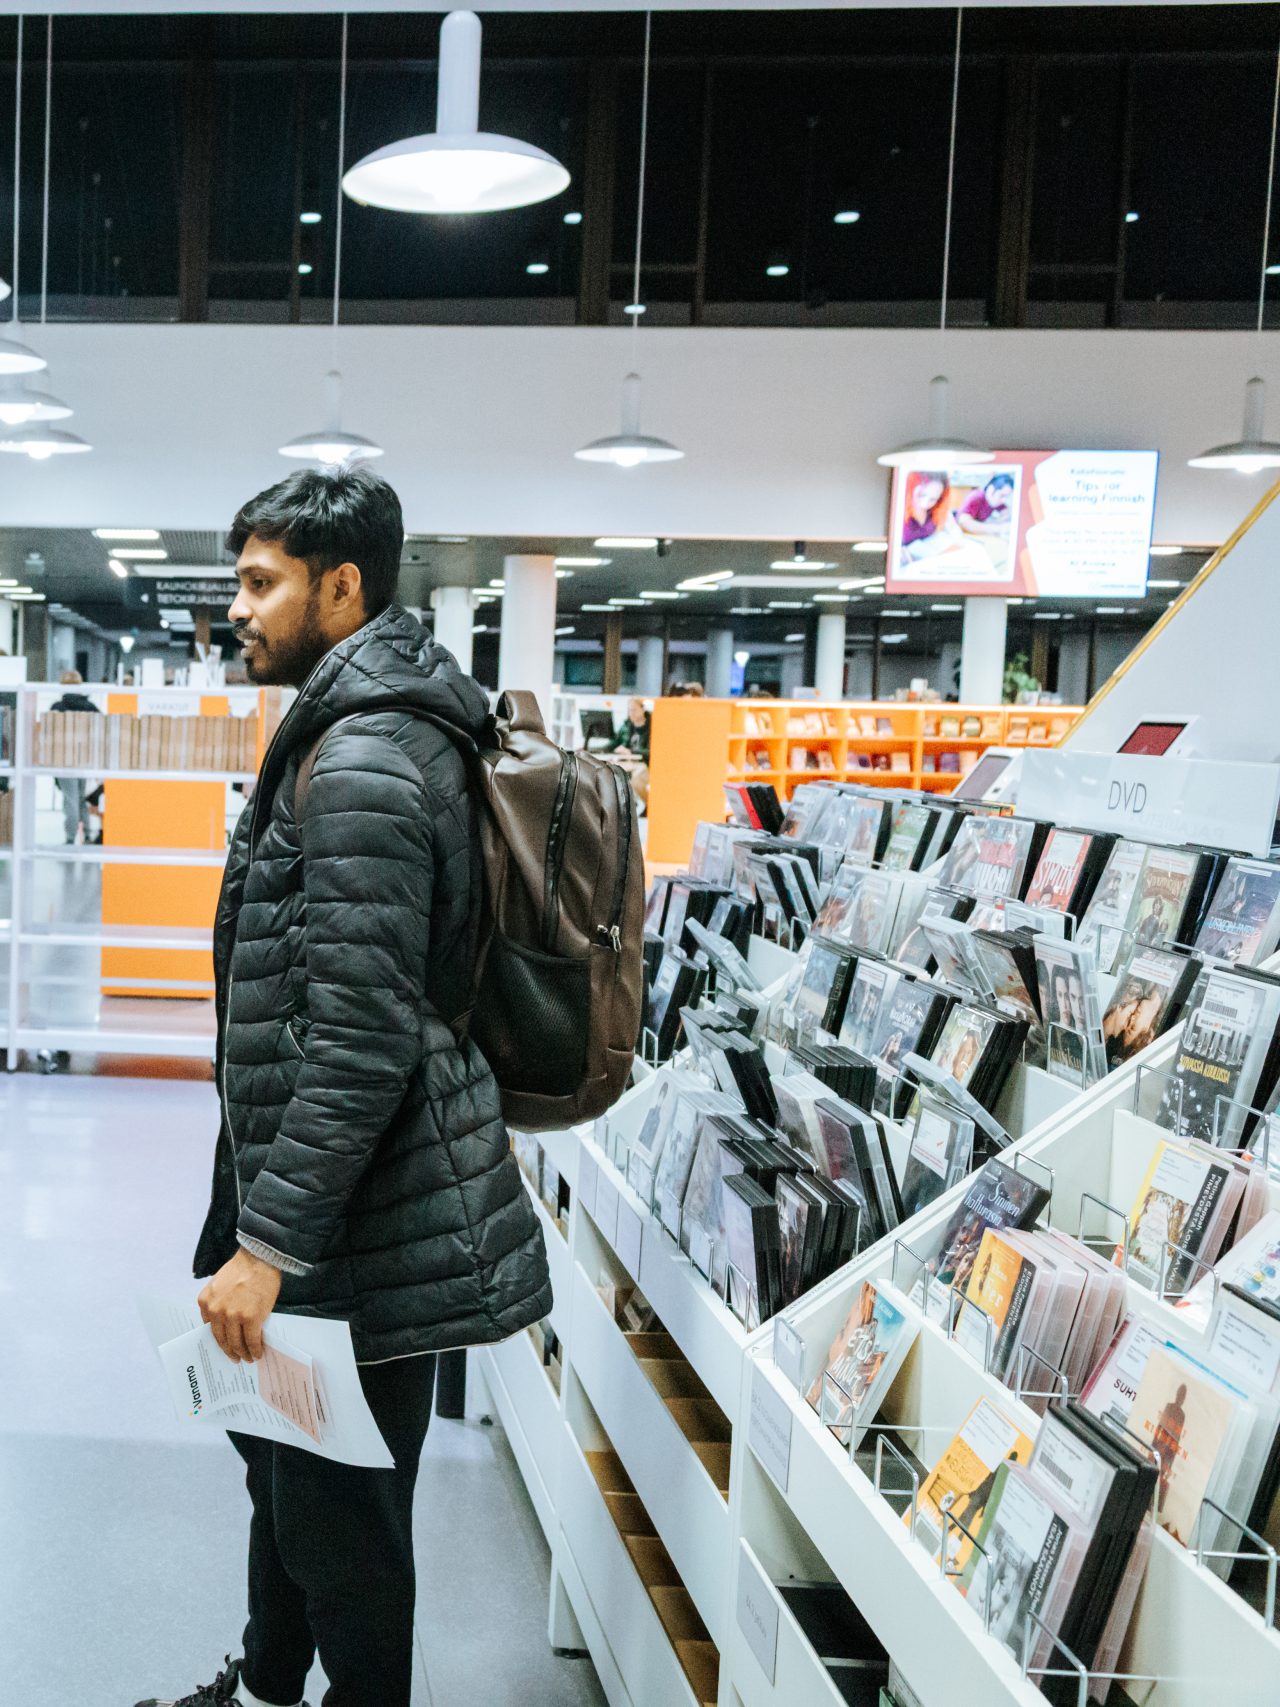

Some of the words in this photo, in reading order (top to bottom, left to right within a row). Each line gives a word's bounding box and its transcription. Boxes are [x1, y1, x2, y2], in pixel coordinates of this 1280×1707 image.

[1107, 780, 1147, 813] DVD
[987, 1181, 1021, 1217] Sininen
[186, 1365, 202, 1409] Vanamo
